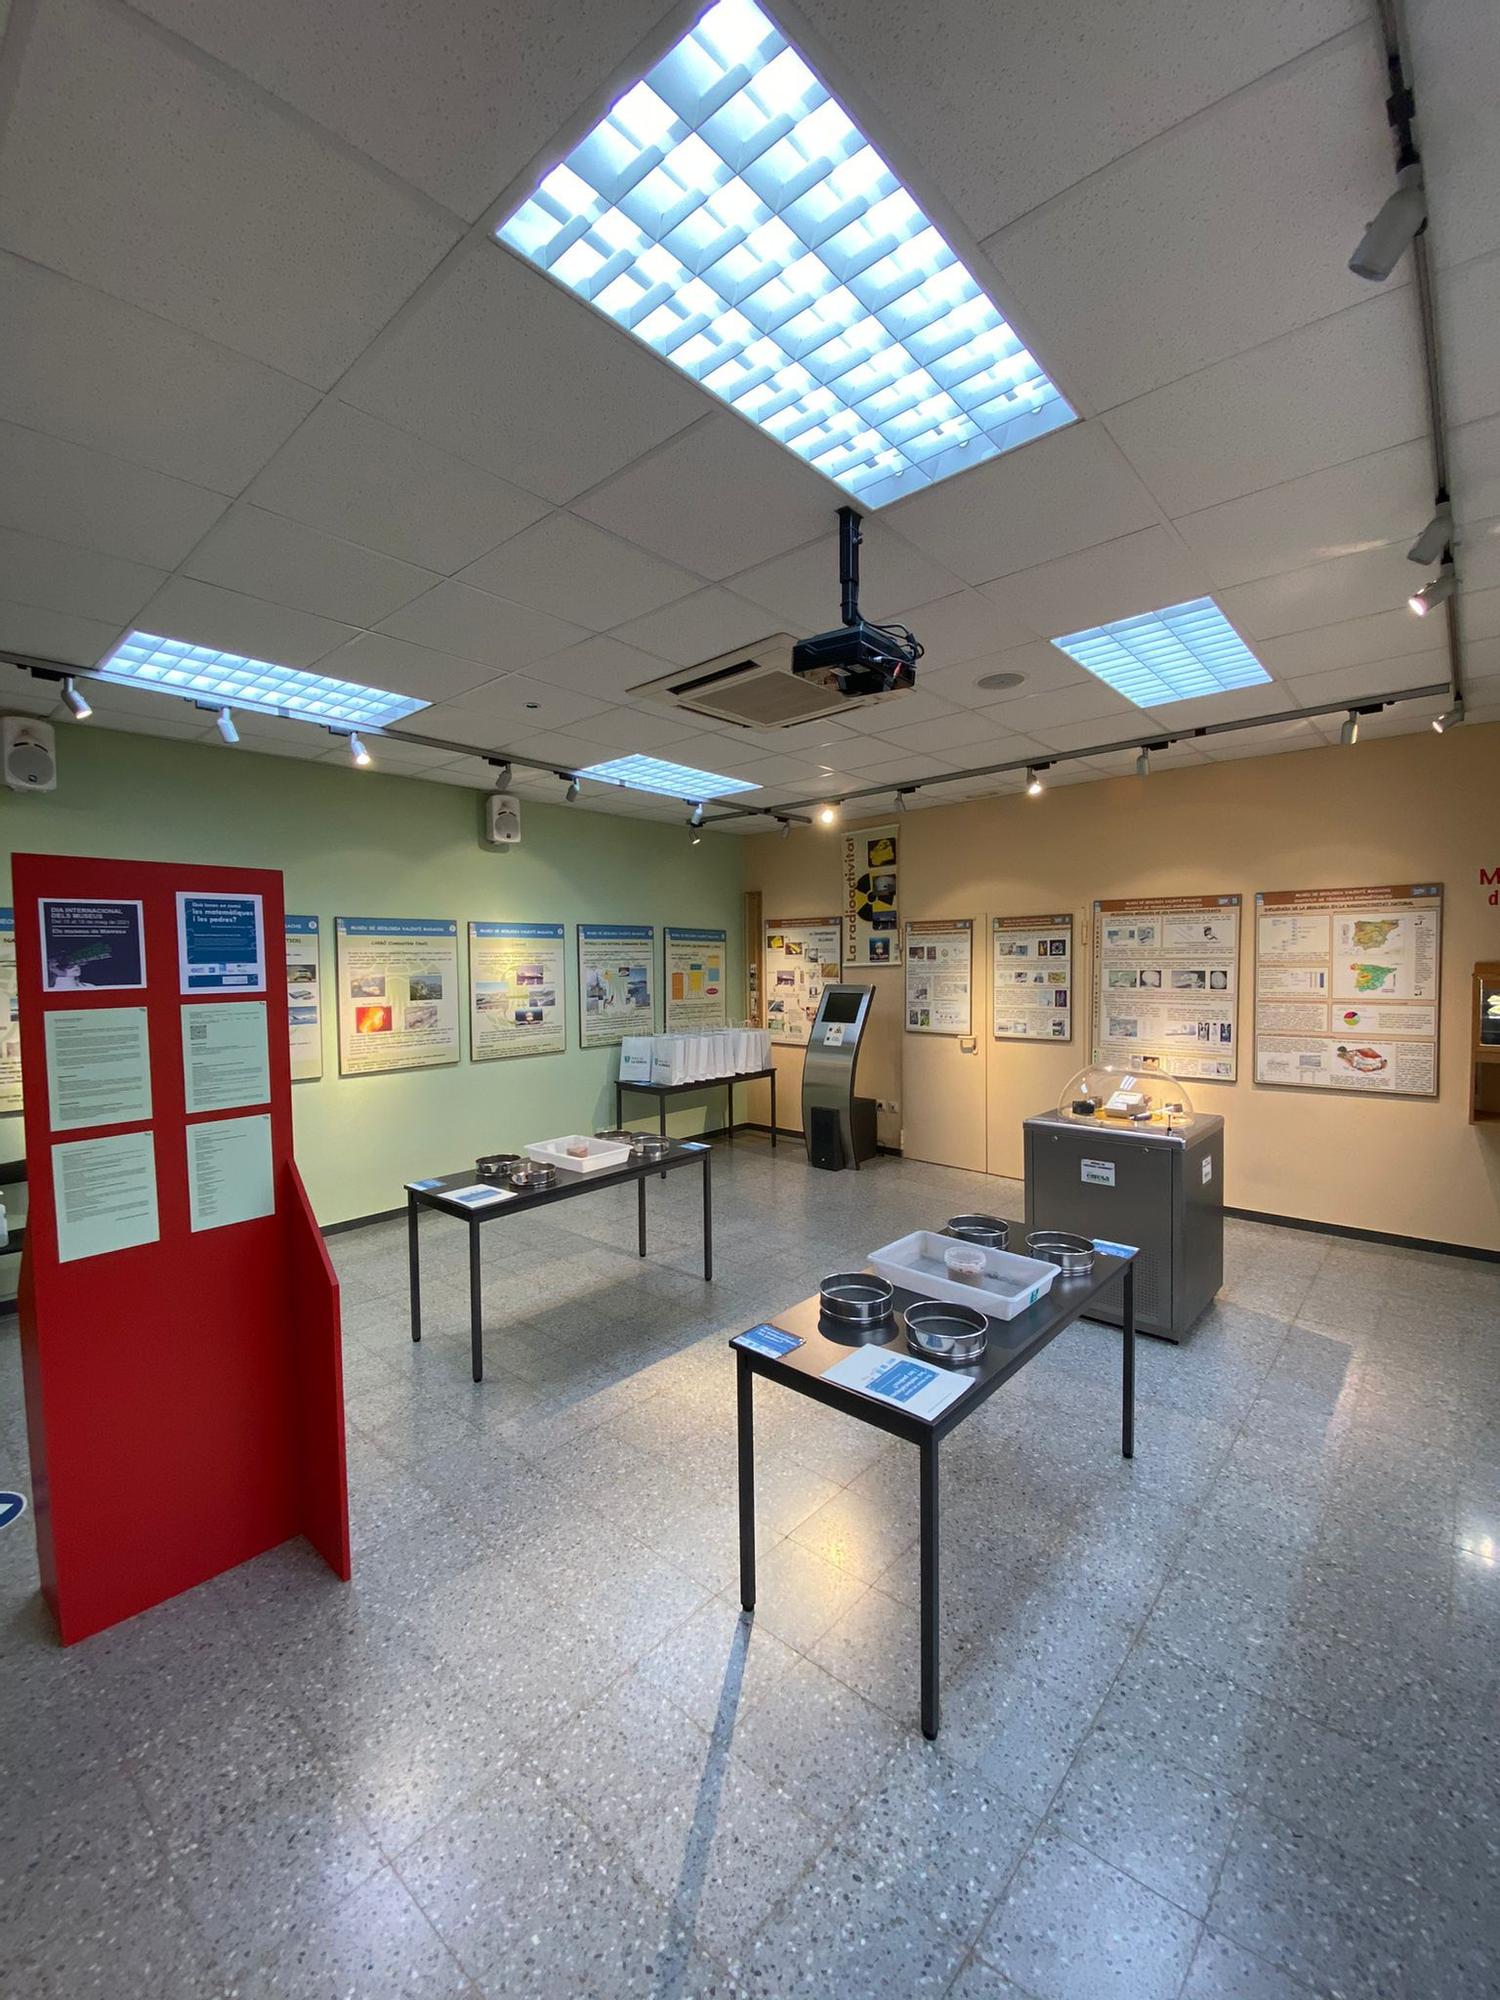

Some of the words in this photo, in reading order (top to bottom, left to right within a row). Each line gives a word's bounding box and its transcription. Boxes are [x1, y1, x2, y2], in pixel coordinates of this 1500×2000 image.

[845, 837, 857, 940] radioactivitat
[209, 916, 237, 924] pedres?
[846, 945, 856, 962] La
